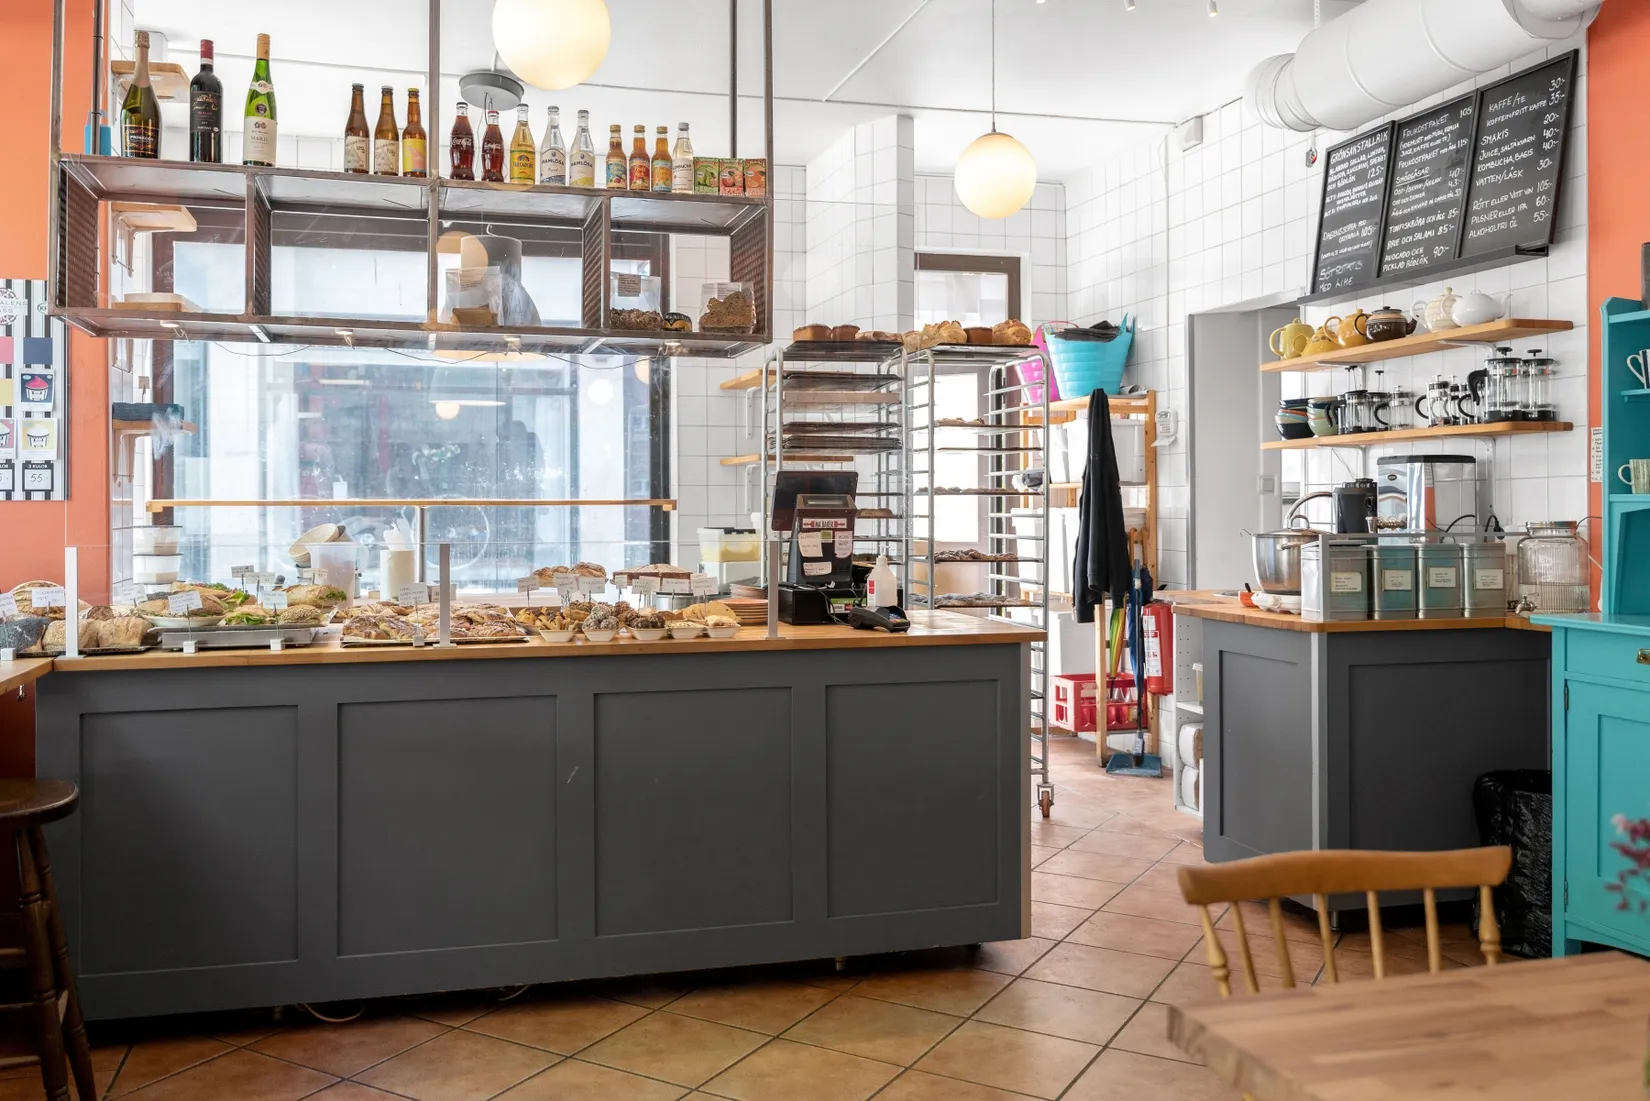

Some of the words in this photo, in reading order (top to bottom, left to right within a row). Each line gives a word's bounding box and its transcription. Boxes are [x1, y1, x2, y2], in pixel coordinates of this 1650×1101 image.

[1488, 92, 1526, 112] KAFFE/TE
[1486, 106, 1528, 127] KOFFEINFRITT
[1529, 100, 1546, 112] KAFFE
[1403, 114, 1449, 139] FRUKOSTPAKET
[1480, 128, 1508, 146] SMAKIS
[1414, 143, 1430, 153] KAFFE
[1480, 148, 1500, 160] JUICE,
[1398, 148, 1440, 169] FRUKOSTPAKET
[1473, 198, 1490, 210] RÖTT
[1490, 194, 1508, 206] ELLER
[1510, 189, 1523, 199] VITT
[1524, 187, 1534, 195] VIN
[1471, 210, 1498, 224] PILSNER
[1498, 206, 1516, 217] ELLER
[1518, 202, 1528, 212] IPA
[1468, 221, 1508, 238] ALKOHOLFRI
[1509, 216, 1518, 228] ÖL
[1387, 238, 1400, 250] BRIE
[1402, 235, 1412, 244] OCH
[1413, 230, 1434, 241] SALAMI
[1384, 250, 1410, 262] AVOCADO
[1411, 246, 1424, 256] OCH
[1320, 282, 1332, 292] MED
[1335, 277, 1354, 288] LIME
